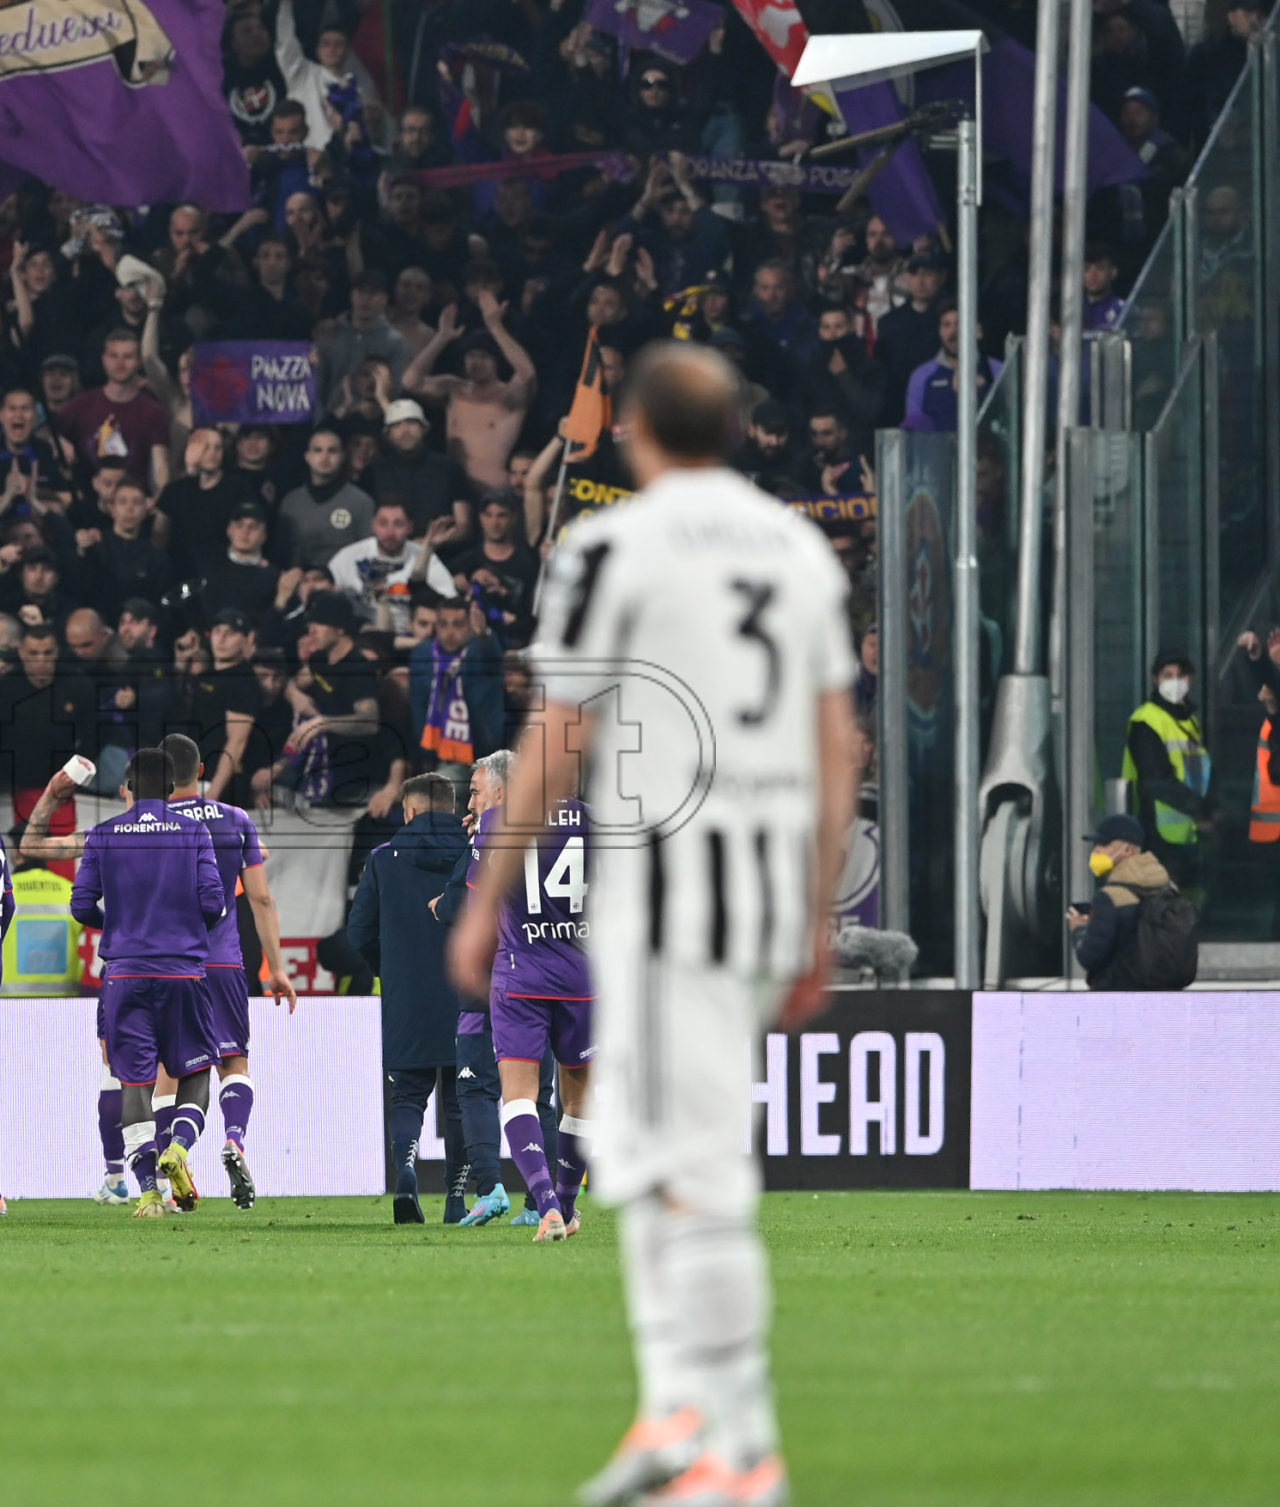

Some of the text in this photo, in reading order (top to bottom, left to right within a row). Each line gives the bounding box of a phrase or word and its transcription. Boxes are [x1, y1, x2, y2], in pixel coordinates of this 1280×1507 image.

[251, 354, 312, 380] PIAZZA
[256, 382, 311, 412] NOVA
[728, 573, 783, 727] 3
[113, 821, 182, 834] FIORENTINA
[524, 836, 588, 914] 14
[522, 920, 590, 944] prima
